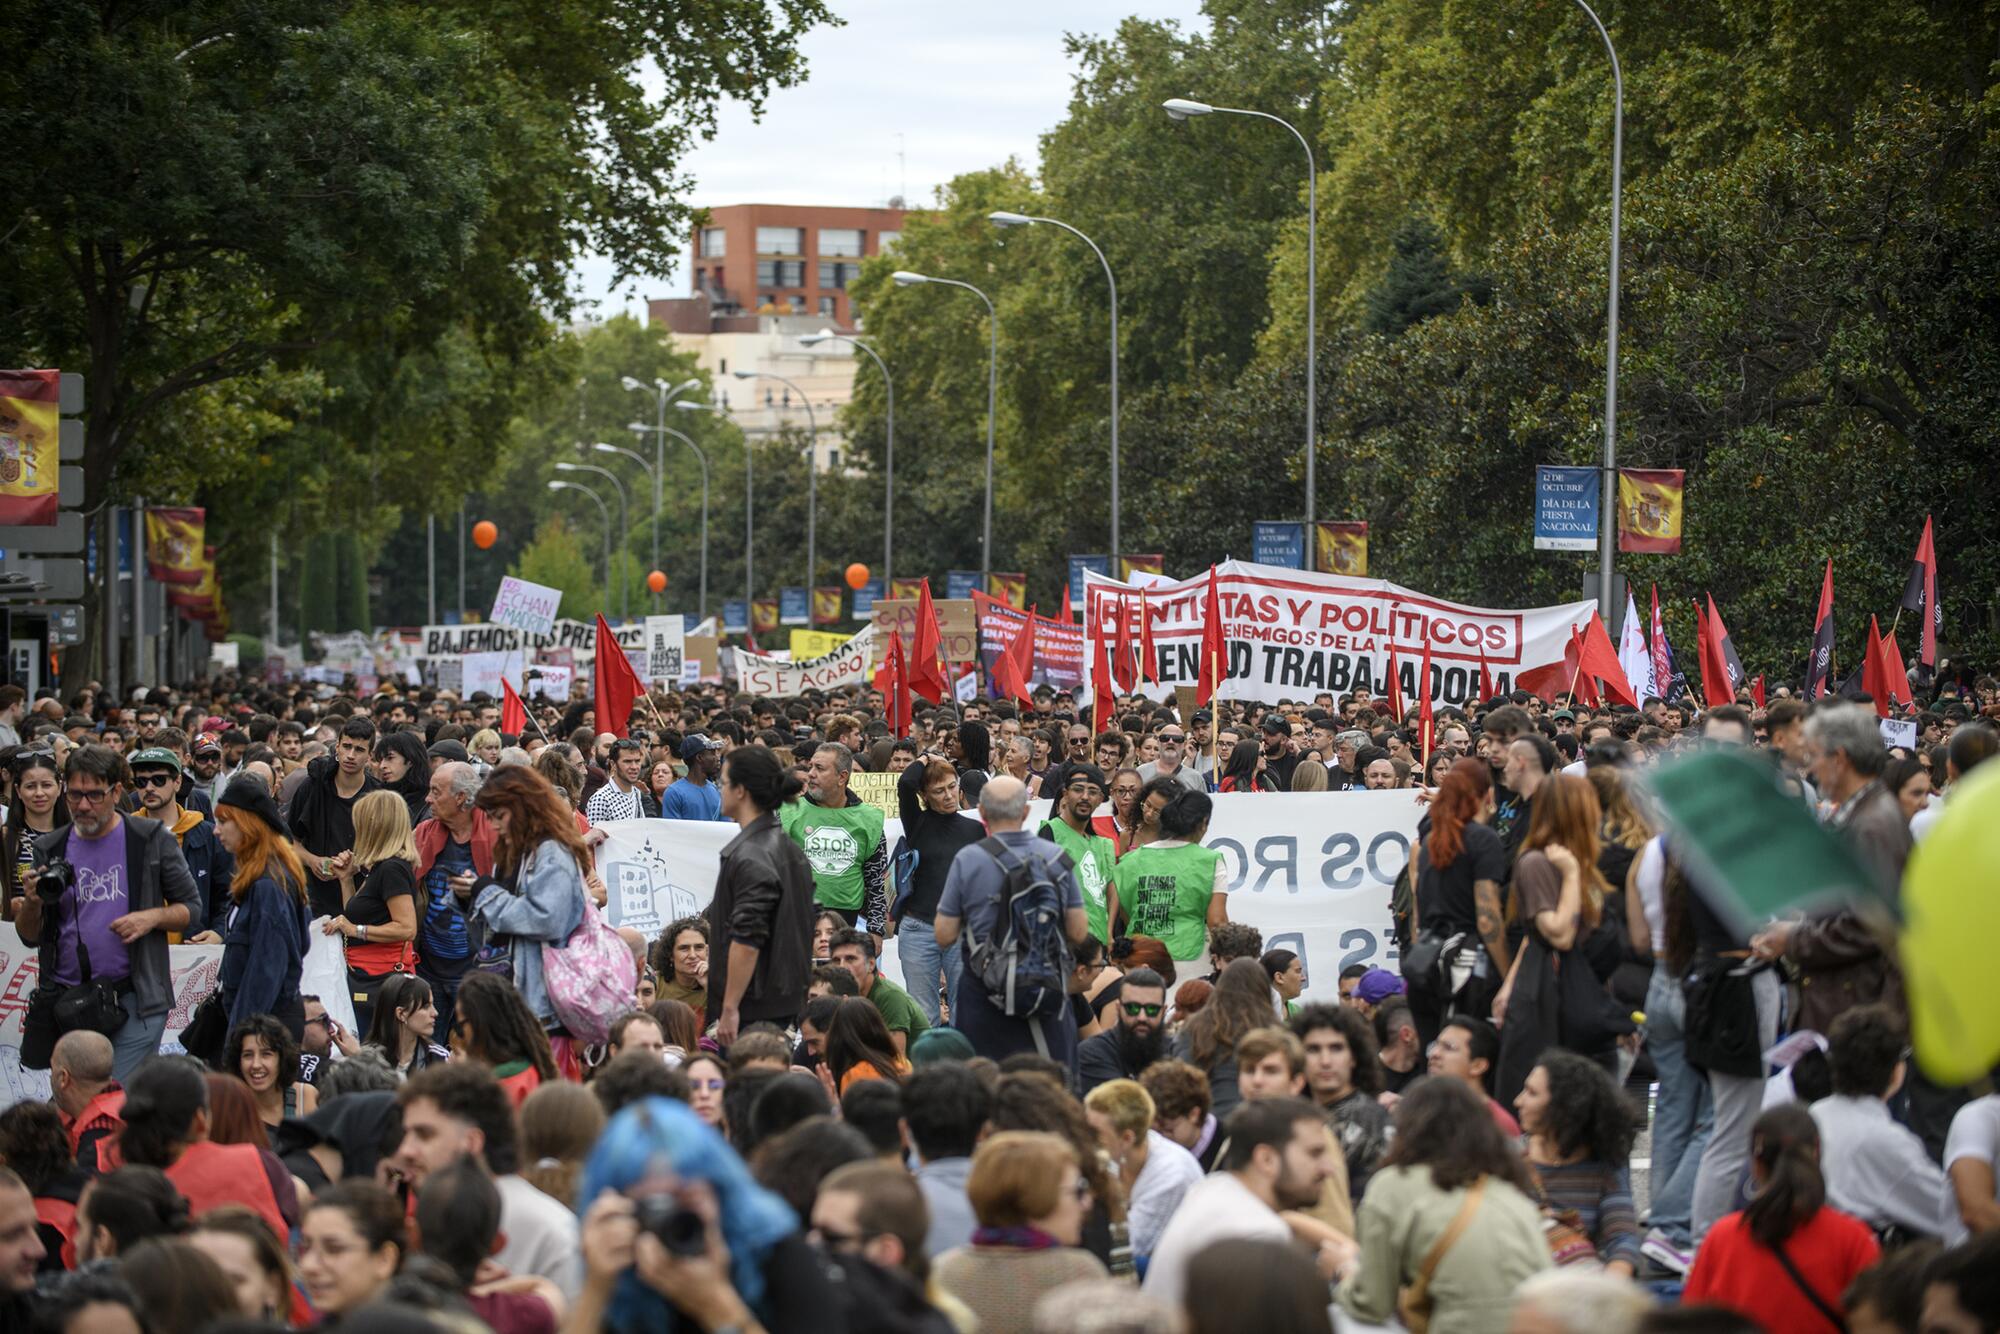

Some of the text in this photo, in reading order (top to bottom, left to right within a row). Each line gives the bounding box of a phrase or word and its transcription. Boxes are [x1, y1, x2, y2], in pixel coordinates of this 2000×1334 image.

[1552, 474, 1564, 482] DE
[1542, 484, 1584, 492] OCTUBRE
[1543, 498, 1591, 509] DÍA DE LA
[1542, 511, 1575, 520] FIESTA
[1541, 522, 1594, 532] NACIONAL
[502, 590, 554, 617] ECHAN
[1287, 598, 1312, 626] Y
[1319, 602, 1506, 650] POLÍTICOS
[427, 628, 519, 655] BAJEMOS
[1321, 633, 1347, 650] DE
[1351, 641, 1376, 652] LA
[811, 837, 852, 852] STOP
